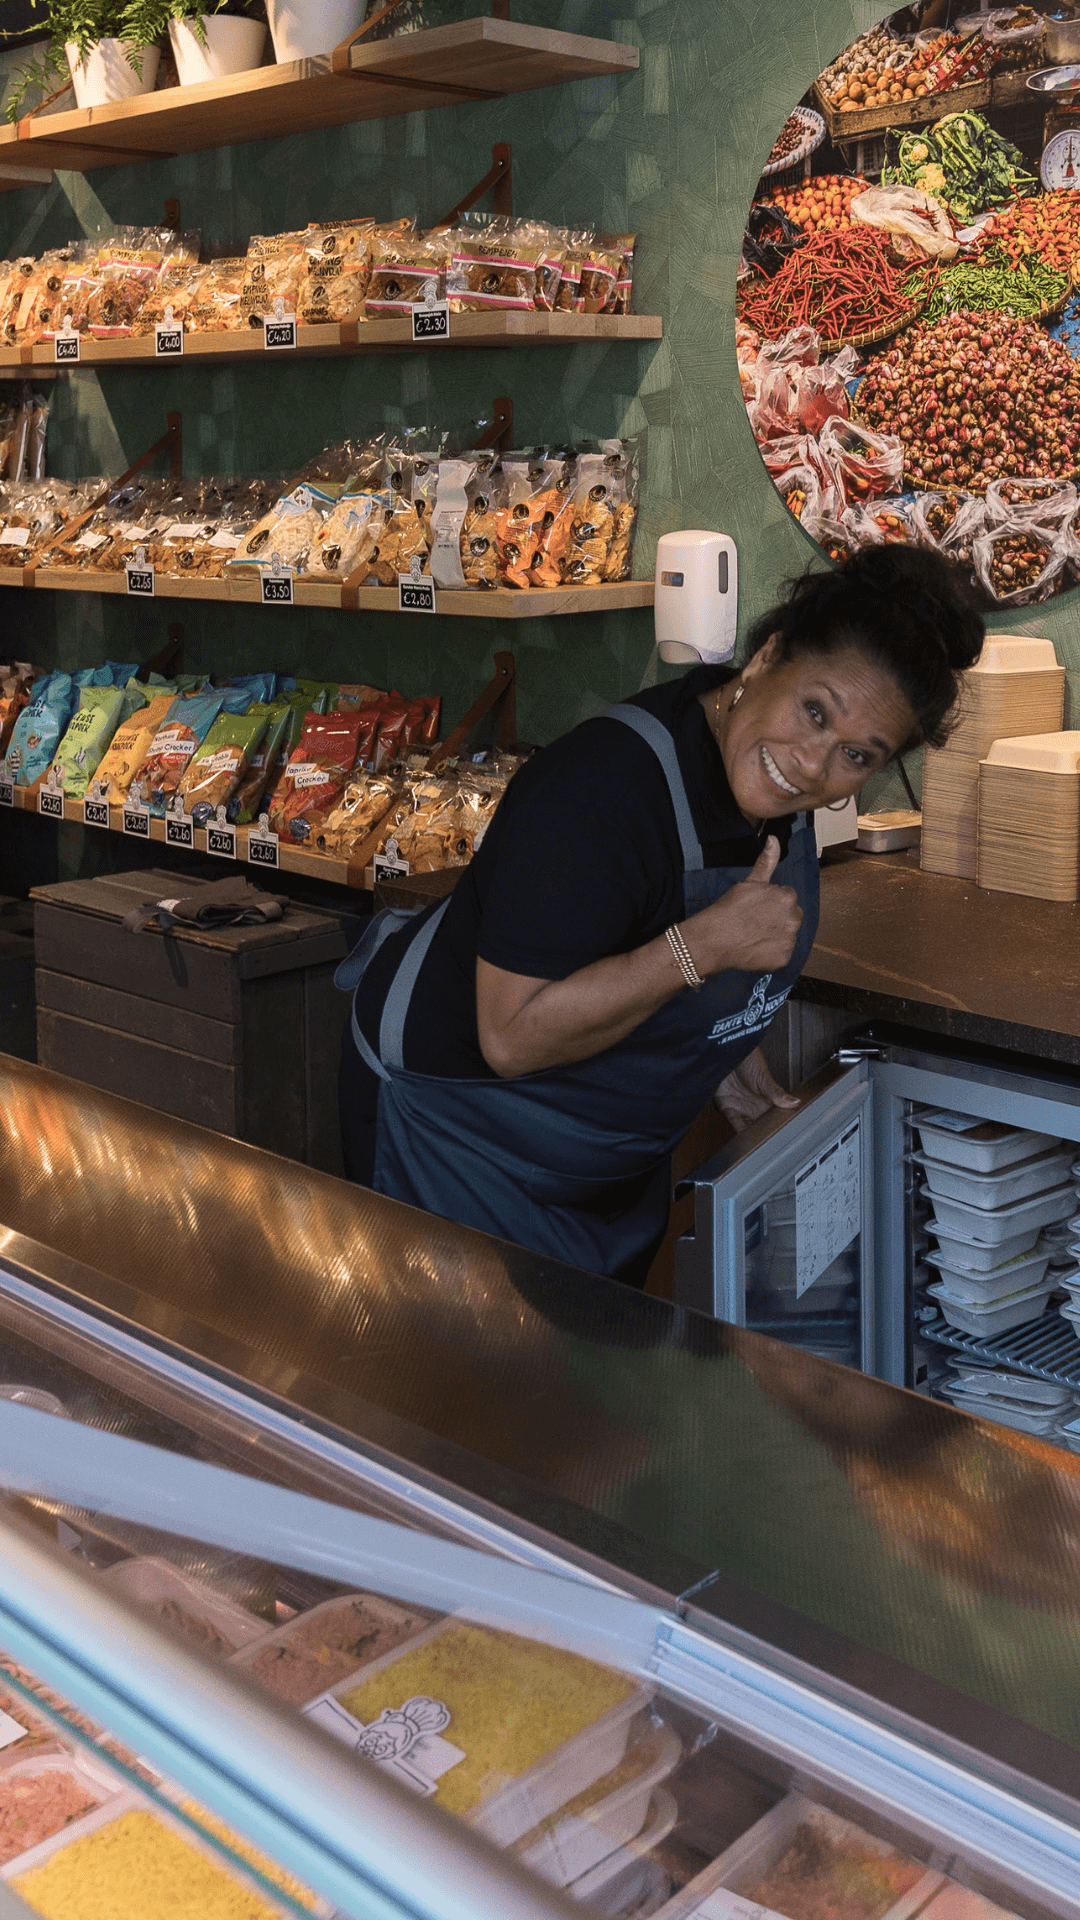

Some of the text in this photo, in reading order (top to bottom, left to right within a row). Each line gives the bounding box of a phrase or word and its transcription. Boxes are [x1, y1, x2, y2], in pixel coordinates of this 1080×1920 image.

[478, 245, 517, 259] REMPEJEH
[243, 284, 267, 295] EMPING
[403, 591, 431, 606] €2,80
[164, 743, 192, 751] Cracker
[297, 776, 326, 784] Cracker
[712, 1014, 744, 1034] TANTE
